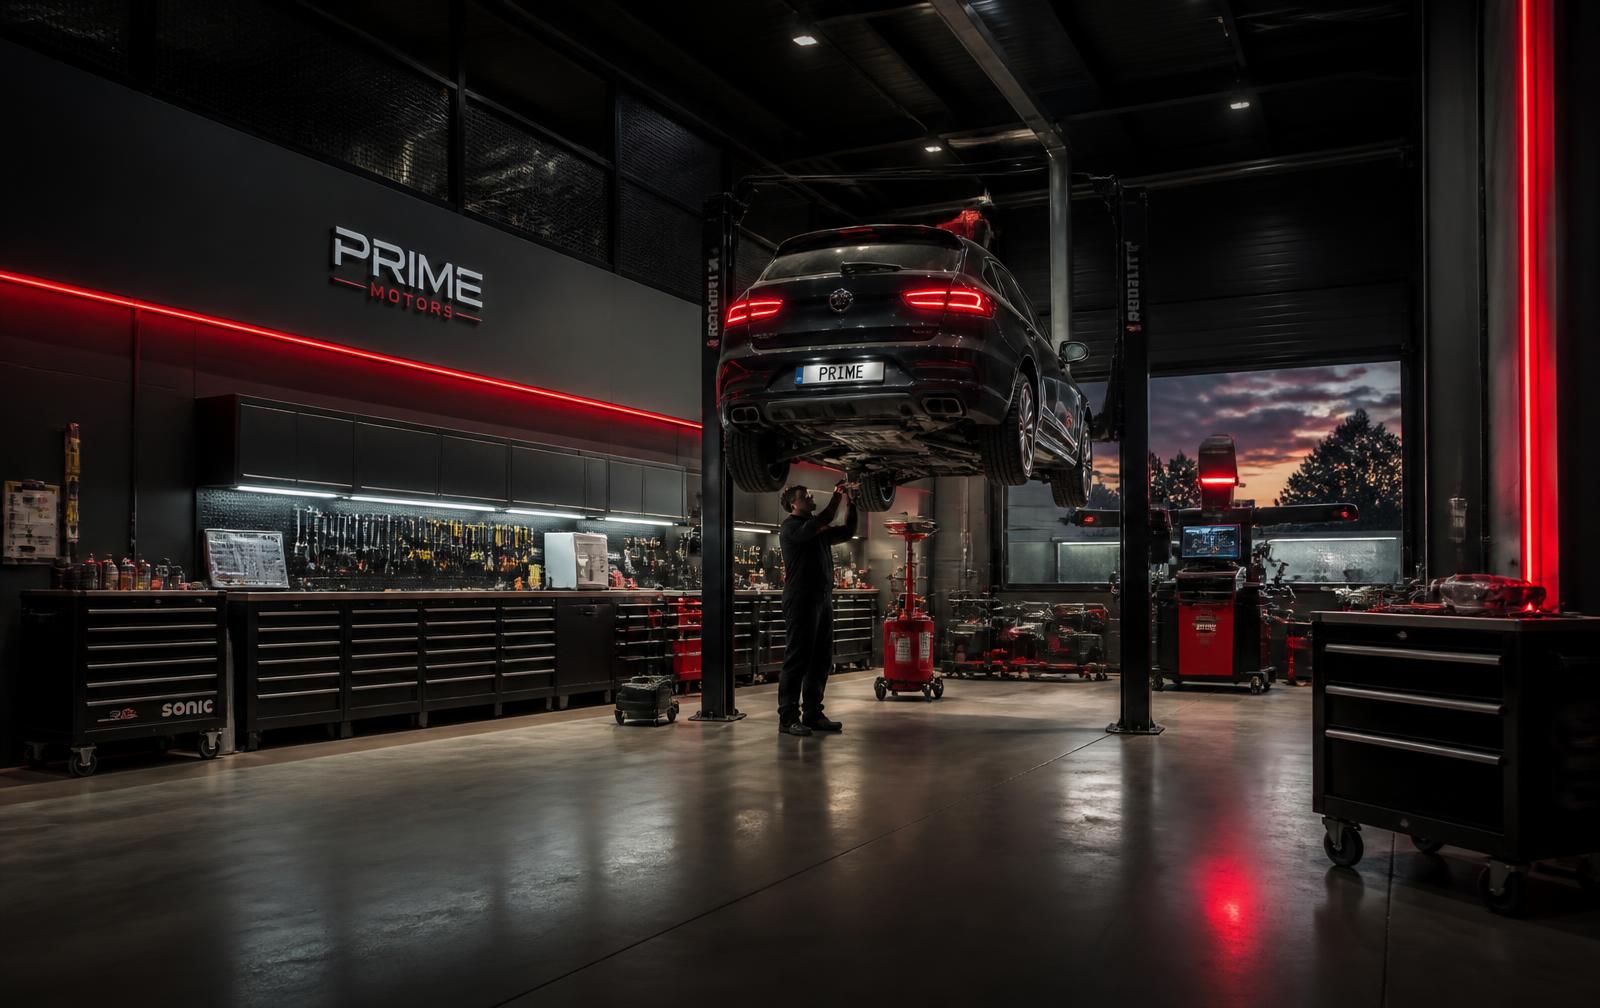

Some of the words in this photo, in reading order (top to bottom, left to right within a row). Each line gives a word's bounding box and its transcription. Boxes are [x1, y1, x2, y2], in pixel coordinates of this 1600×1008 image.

[334, 225, 483, 309] PRIME
[369, 281, 453, 319] MOTORS
[818, 365, 864, 381] PRIME
